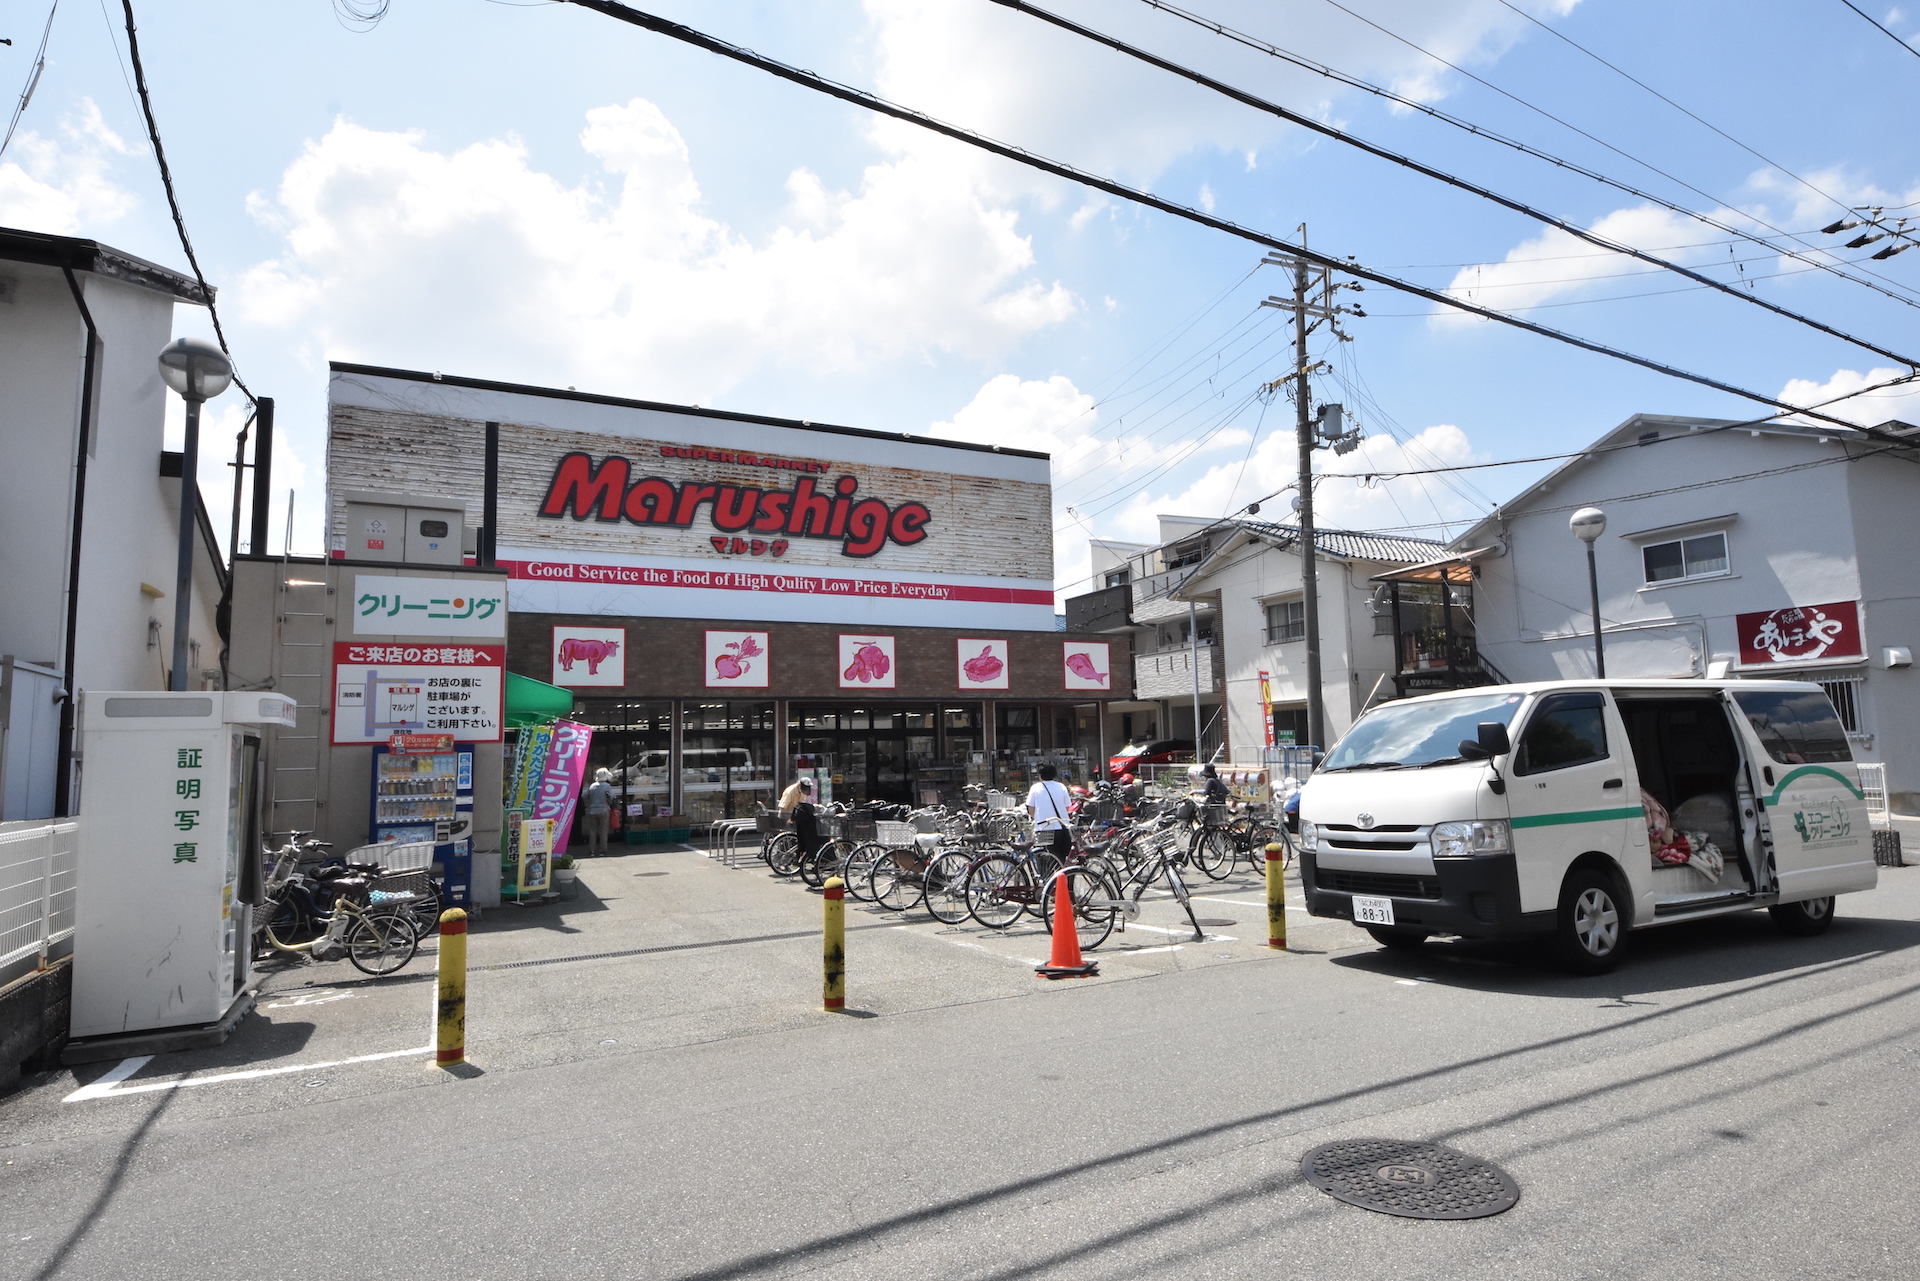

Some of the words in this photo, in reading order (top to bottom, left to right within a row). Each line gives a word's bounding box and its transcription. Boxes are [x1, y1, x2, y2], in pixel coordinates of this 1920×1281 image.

[537, 451, 932, 558] Marushige
[527, 562, 574, 578] Good
[579, 564, 639, 581] Service
[643, 569, 668, 583] the
[672, 570, 710, 585] Food
[715, 572, 731, 586] of
[734, 574, 769, 590] High
[773, 575, 817, 593] Qulity
[821, 578, 850, 592] Low
[854, 580, 888, 594] Price
[891, 582, 950, 599] Everyday
[358, 594, 501, 619] クリーニング
[349, 646, 492, 664] ご来店のお客様へ
[427, 677, 482, 688] お店の裏に
[427, 692, 471, 702] 駐車場が
[391, 703, 415, 712] マルシゲ
[427, 705, 486, 715] ございます。
[427, 719, 497, 729] ご利用下さい。
[576, 729, 589, 757] エコー
[517, 732, 551, 809] ゆかたクリーニ
[539, 726, 579, 818] クリーニング
[172, 748, 203, 864] 証明写真
[1807, 812, 1831, 825] エコー
[1810, 822, 1851, 840] クリーニング
[1362, 907, 1391, 923] 88-31
